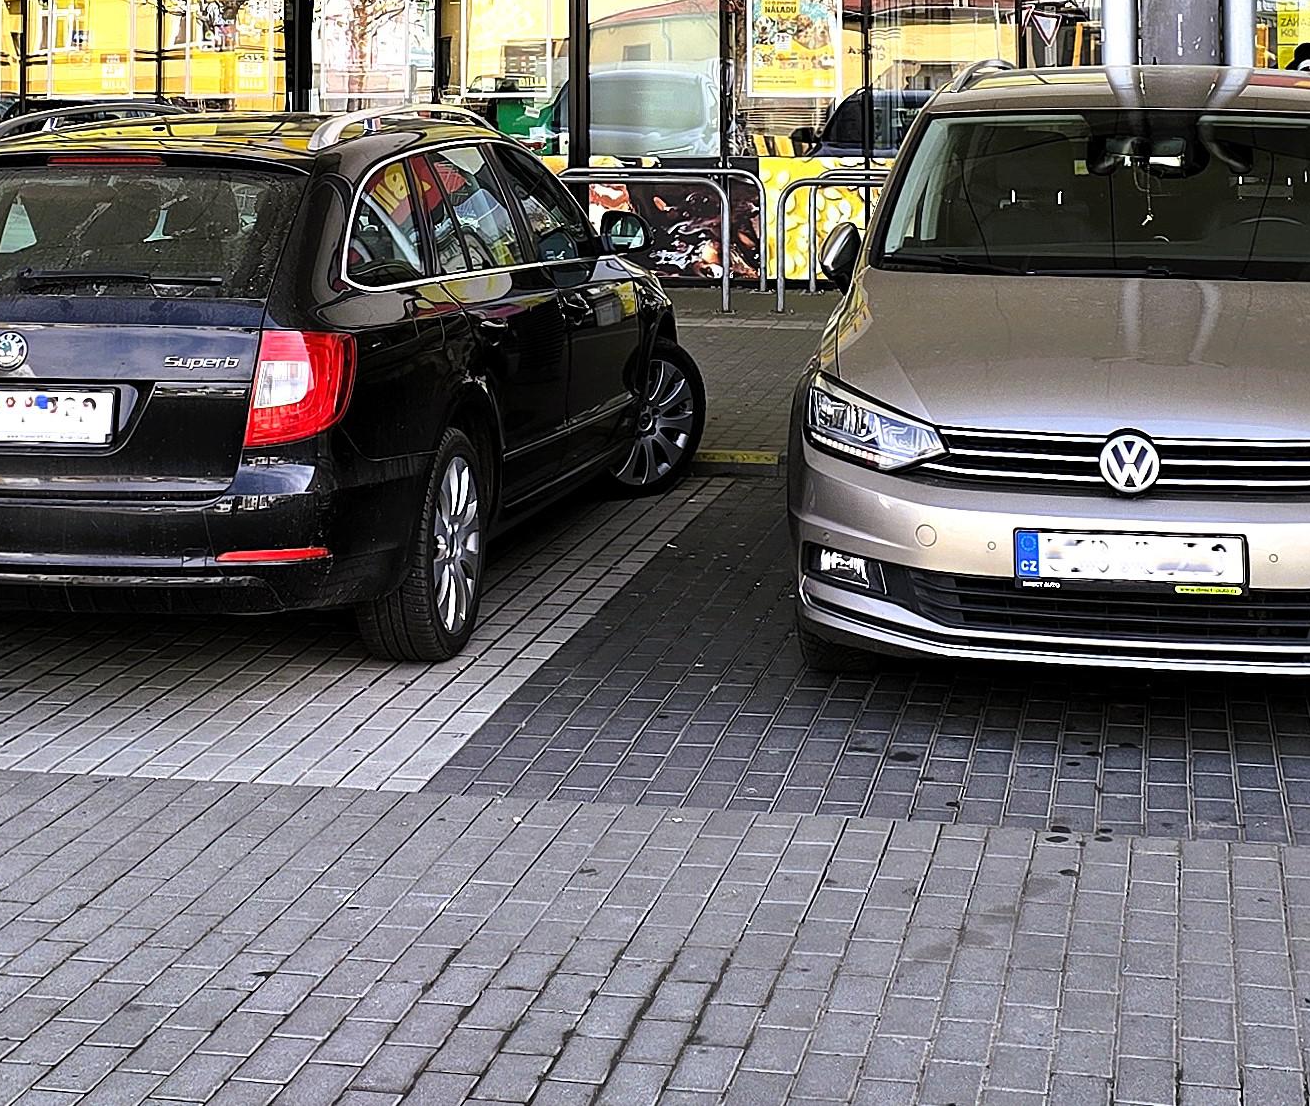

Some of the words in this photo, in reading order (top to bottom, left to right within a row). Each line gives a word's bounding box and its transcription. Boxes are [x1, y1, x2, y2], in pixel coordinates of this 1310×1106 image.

[764, 4, 797, 14] NÁLADU
[164, 356, 240, 369] Superb
[1020, 560, 1038, 572] CZ
